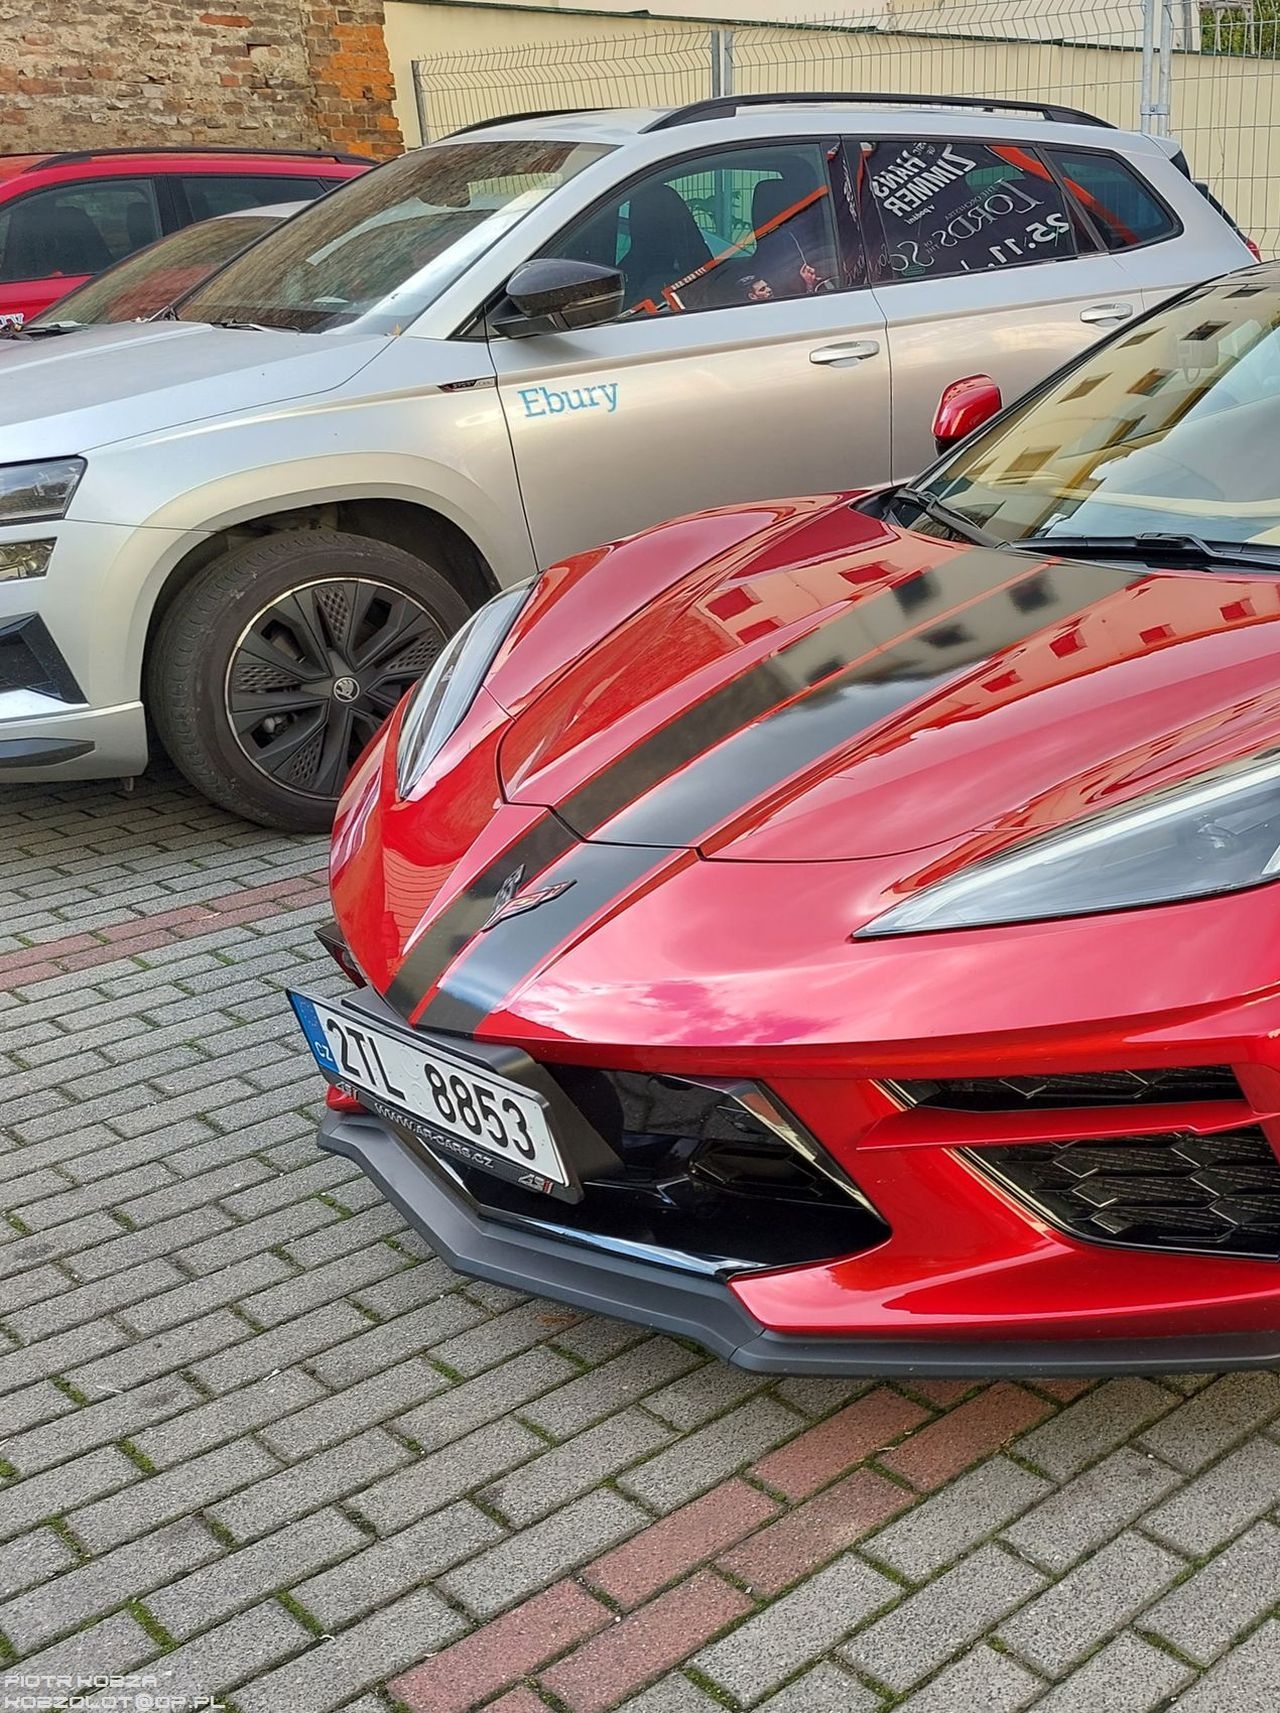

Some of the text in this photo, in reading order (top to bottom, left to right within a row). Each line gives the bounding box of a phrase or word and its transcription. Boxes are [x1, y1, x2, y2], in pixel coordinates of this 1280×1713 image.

[518, 382, 619, 418] Ebury
[314, 1039, 334, 1063] CZ
[326, 1017, 537, 1161] 2TL 8853
